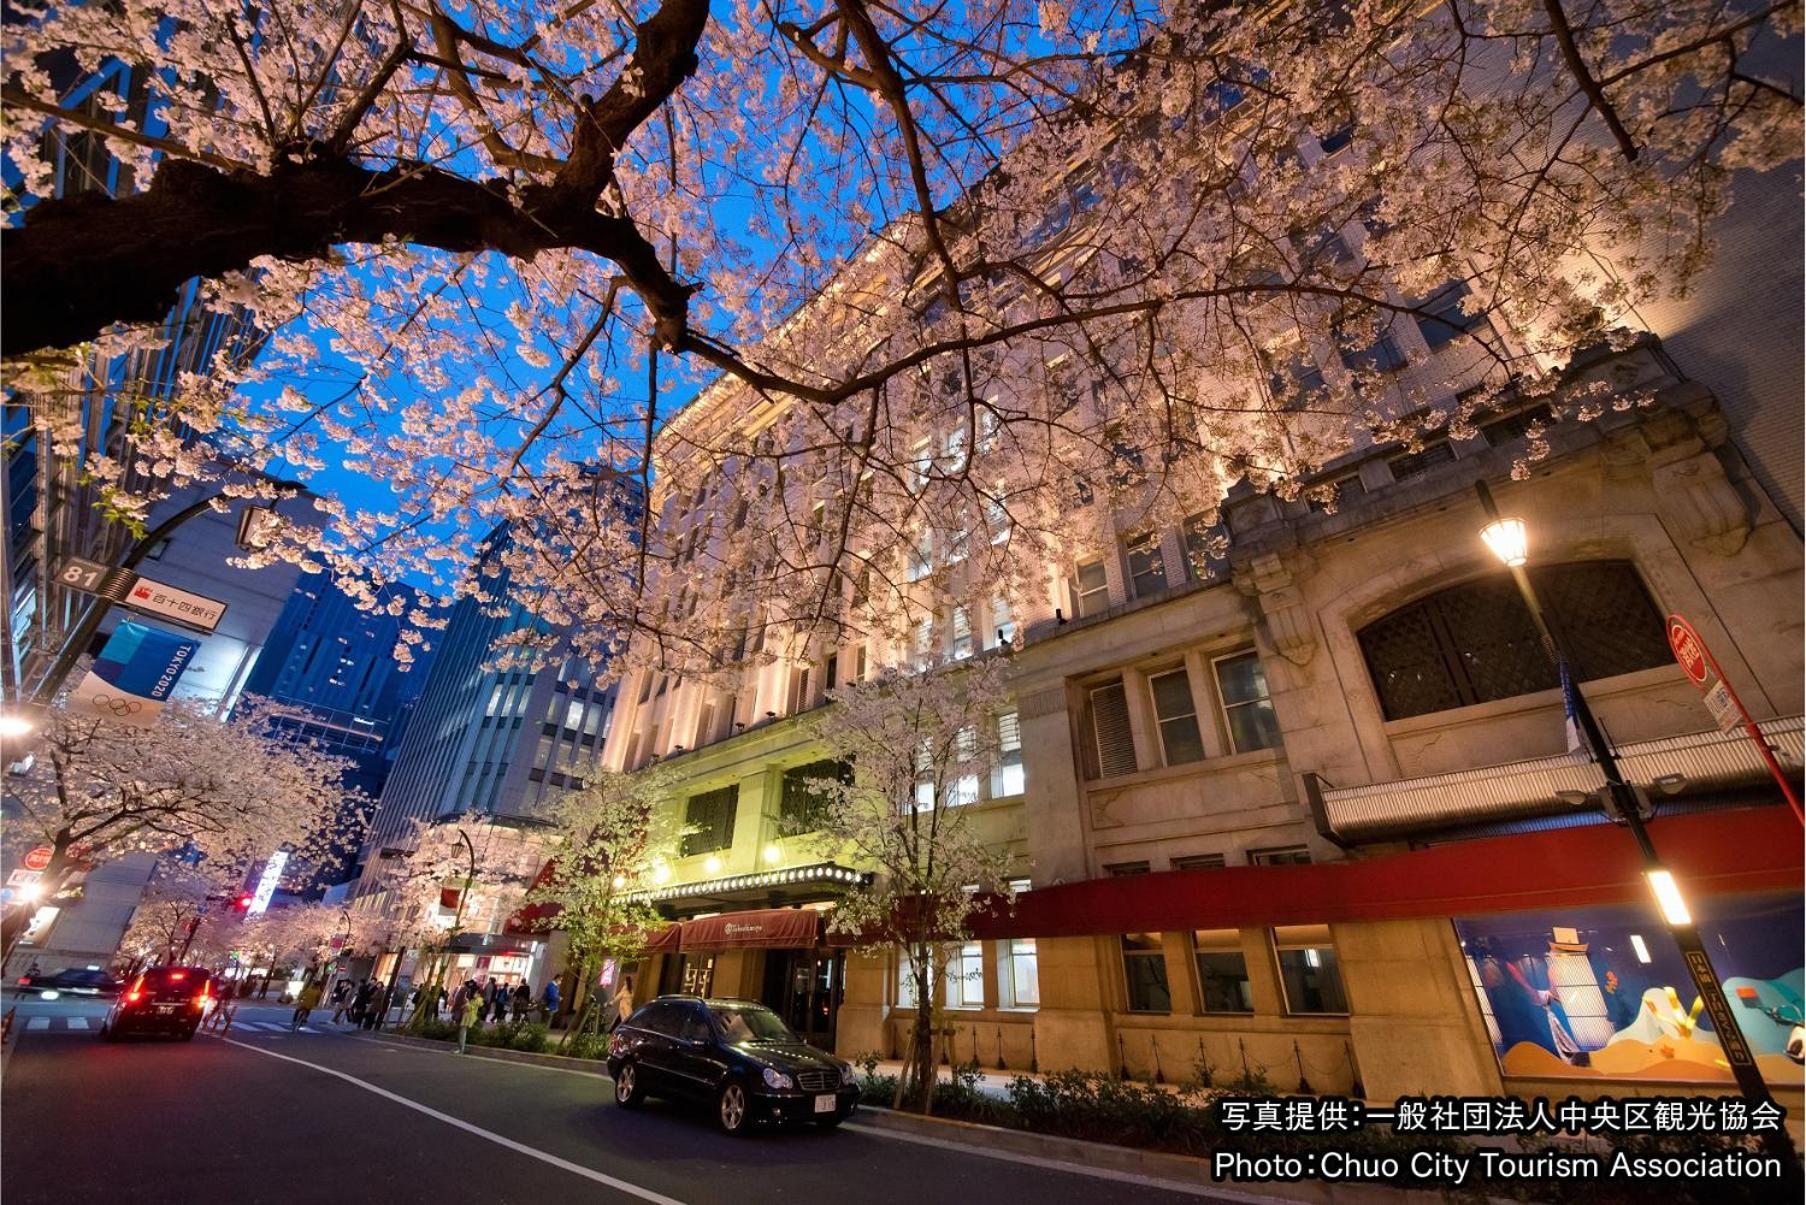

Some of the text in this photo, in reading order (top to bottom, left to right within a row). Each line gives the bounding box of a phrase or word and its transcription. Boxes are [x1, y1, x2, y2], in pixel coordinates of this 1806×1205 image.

[63, 566, 98, 588] 81
[152, 594, 218, 621] 百十四銀行
[151, 644, 192, 698] TOKYO 2020
